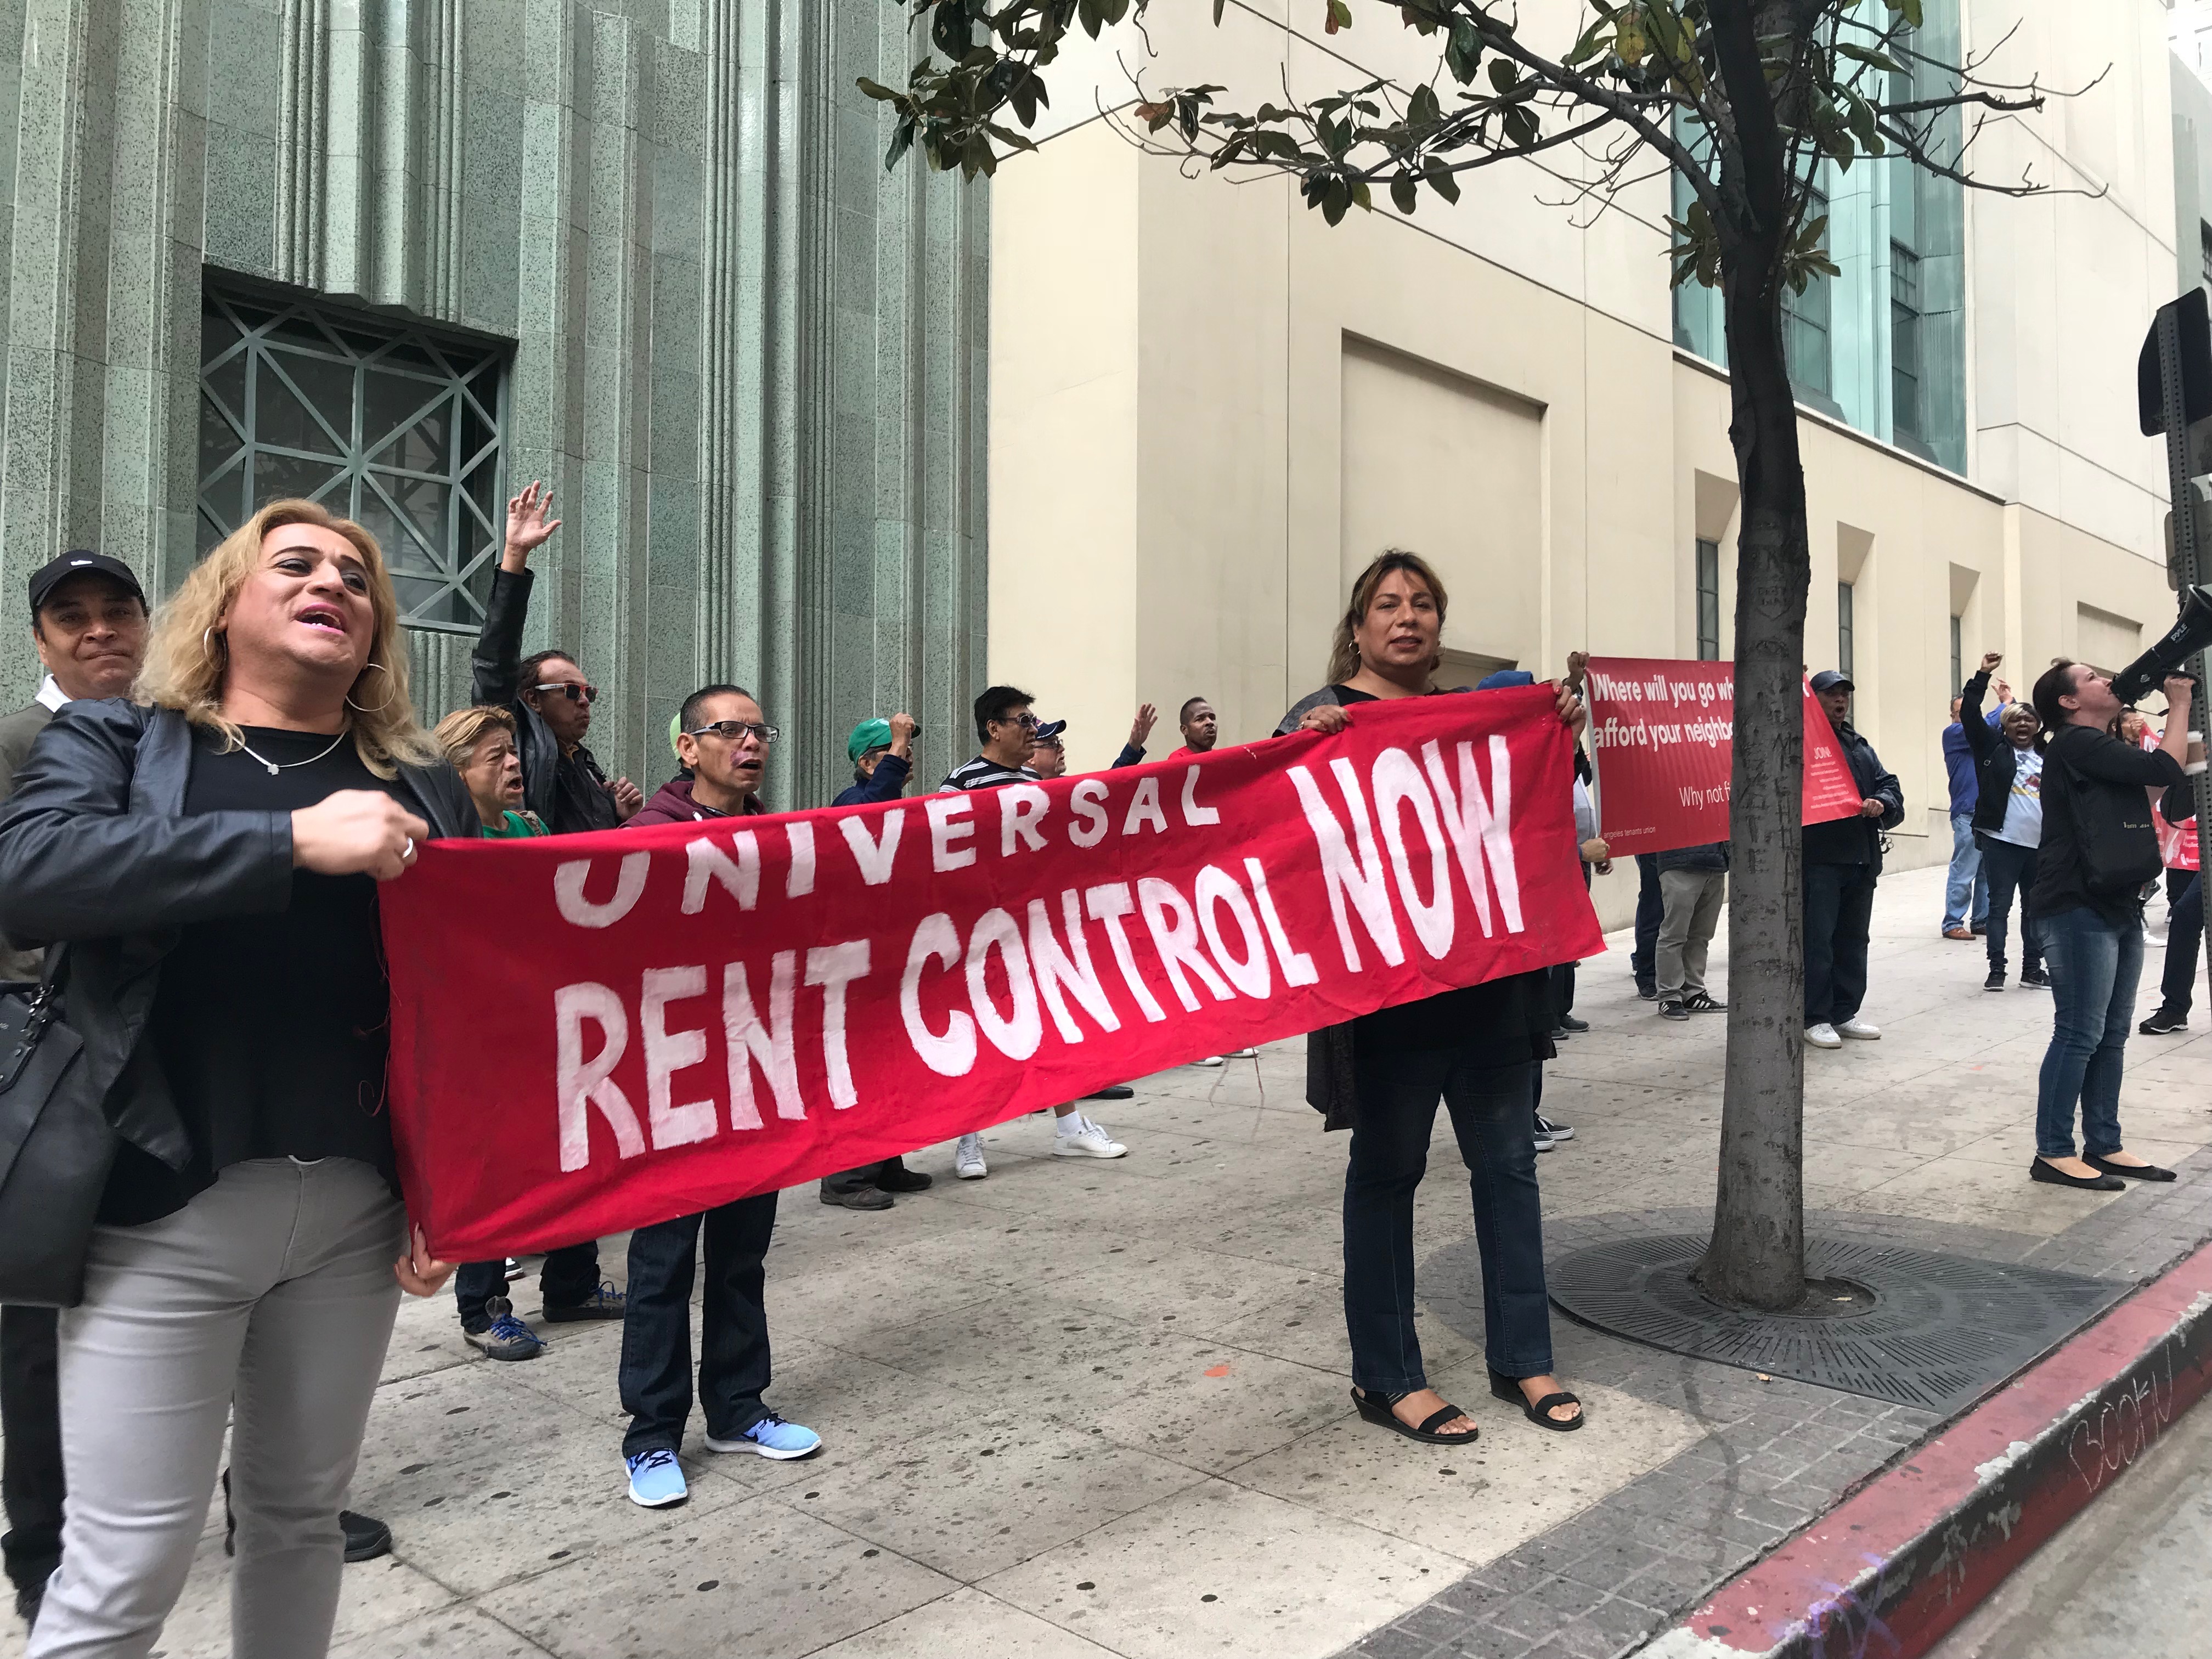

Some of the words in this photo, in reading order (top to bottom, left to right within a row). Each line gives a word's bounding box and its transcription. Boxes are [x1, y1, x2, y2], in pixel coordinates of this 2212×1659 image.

[2170, 622, 2188, 642] PYLE
[1590, 673, 1642, 702] Where
[1644, 674, 1668, 701] will
[1669, 682, 1697, 708] you
[1698, 682, 1716, 708] go
[1593, 716, 1647, 749] afford
[1648, 724, 1682, 753] your
[1679, 786, 1703, 810] Why
[1706, 784, 1725, 804] not
[554, 764, 1221, 929] UNIVERSAL
[1604, 830, 1624, 840] angeles
[1624, 828, 1643, 836] tenants
[1643, 826, 1656, 834] union
[555, 939, 871, 1173] RENT
[900, 857, 1320, 1077] CONTROL
[1286, 734, 1525, 973] NOW
